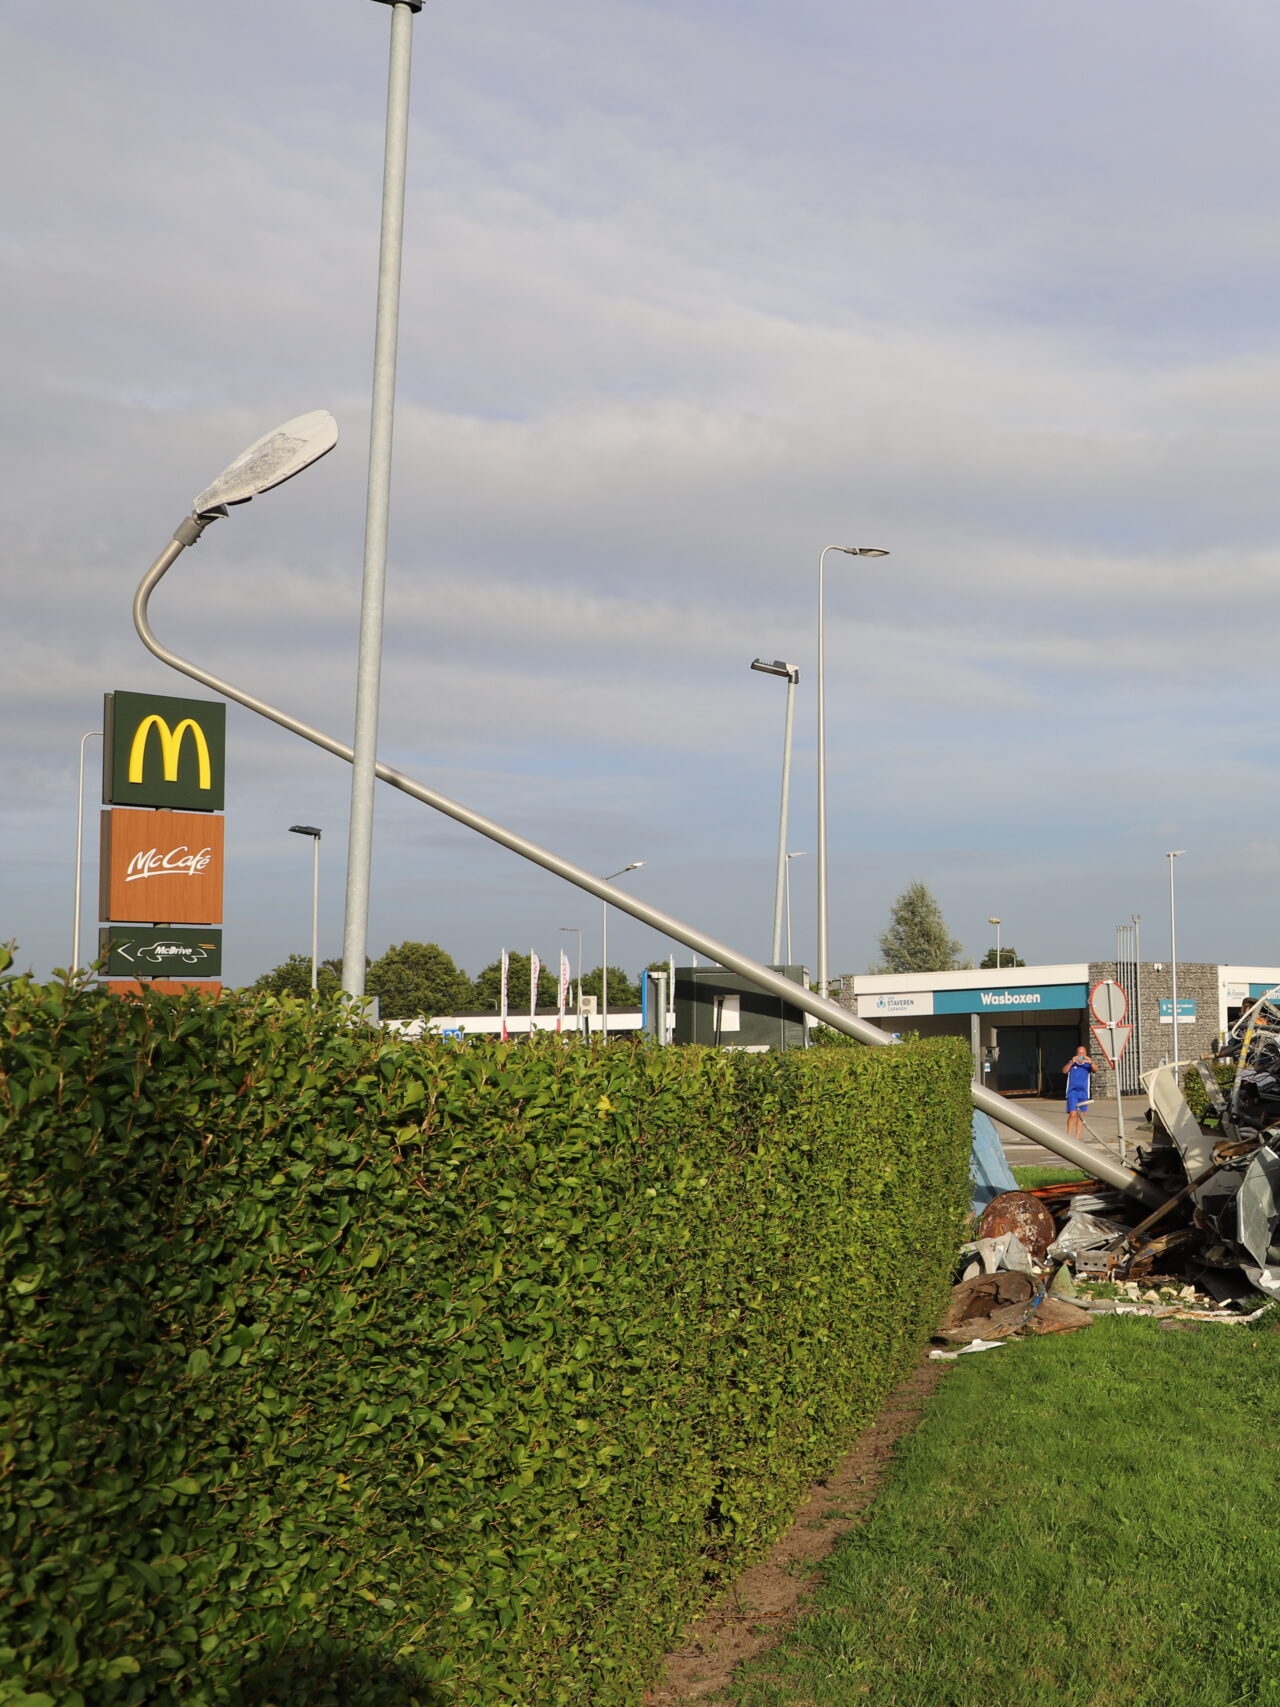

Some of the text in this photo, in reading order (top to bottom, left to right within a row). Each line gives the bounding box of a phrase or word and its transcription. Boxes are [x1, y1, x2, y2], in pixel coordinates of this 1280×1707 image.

[126, 846, 211, 881] McCafé
[154, 946, 192, 956] McDrive
[887, 999, 914, 1007] STAVEREN
[980, 991, 1041, 1006] Wasboxen
